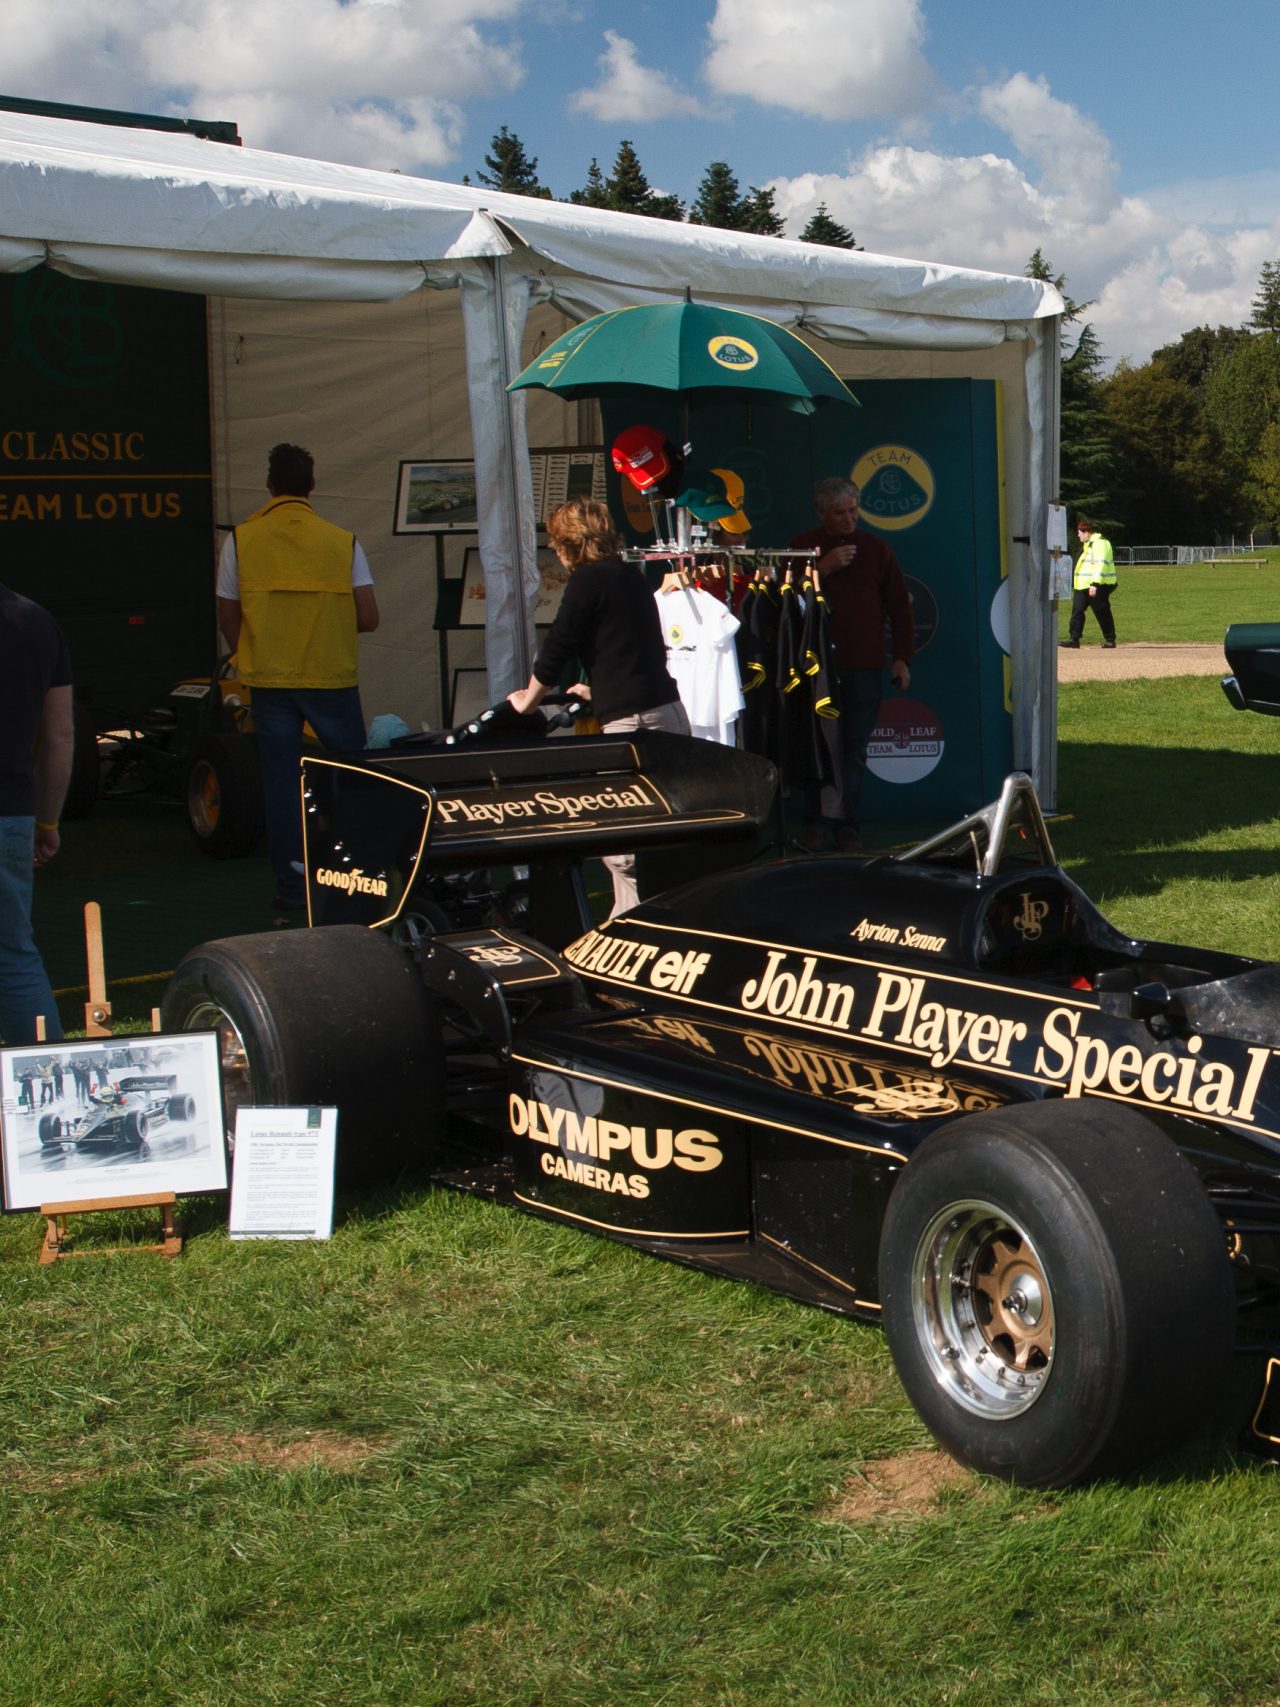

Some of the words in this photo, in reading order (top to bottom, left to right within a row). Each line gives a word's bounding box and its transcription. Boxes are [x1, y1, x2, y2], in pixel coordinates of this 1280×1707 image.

[719, 353, 751, 363] LOTUS
[2, 431, 145, 461] CLASSIC
[867, 449, 912, 467] TEAM
[0, 493, 62, 521] EAM
[76, 492, 183, 520] LOTUS
[865, 493, 921, 512] LOTUS
[871, 727, 895, 737] OLD
[910, 727, 937, 737] LEAF
[437, 800, 536, 824] Player
[535, 785, 655, 817] Special
[850, 918, 900, 941] Ayrton
[898, 925, 947, 952] Senna
[566, 930, 660, 982] ENAULT
[649, 950, 712, 995] elf
[742, 951, 855, 1030] John
[860, 972, 1027, 1068] Player
[1034, 1008, 1273, 1122] Special
[509, 1092, 724, 1173] OLYMPUS
[541, 1152, 651, 1199] CAMERAS
